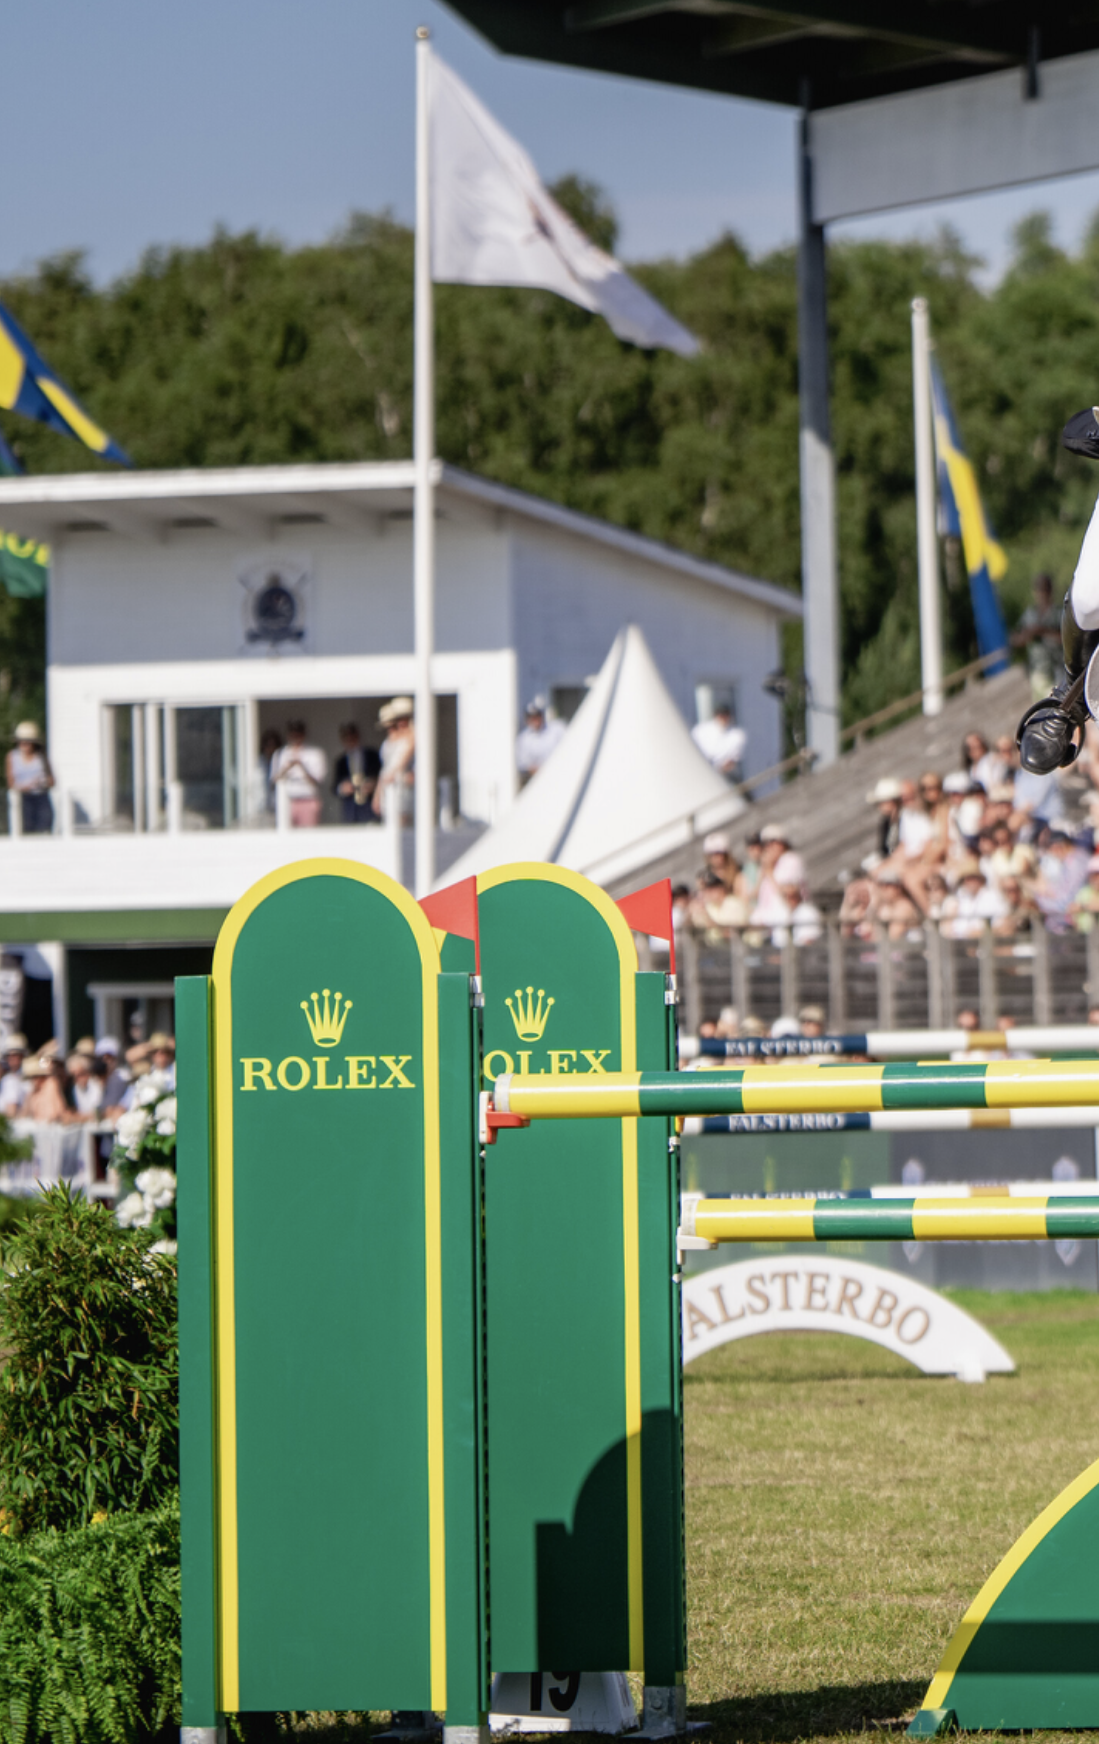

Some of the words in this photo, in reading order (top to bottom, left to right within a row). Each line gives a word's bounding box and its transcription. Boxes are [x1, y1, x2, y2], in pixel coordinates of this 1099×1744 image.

[240, 1055, 415, 1091] ROLEX
[483, 1049, 612, 1082] OLEX
[729, 1113, 846, 1132] FALSTERBO
[684, 1270, 931, 1345] ALSTERBO
